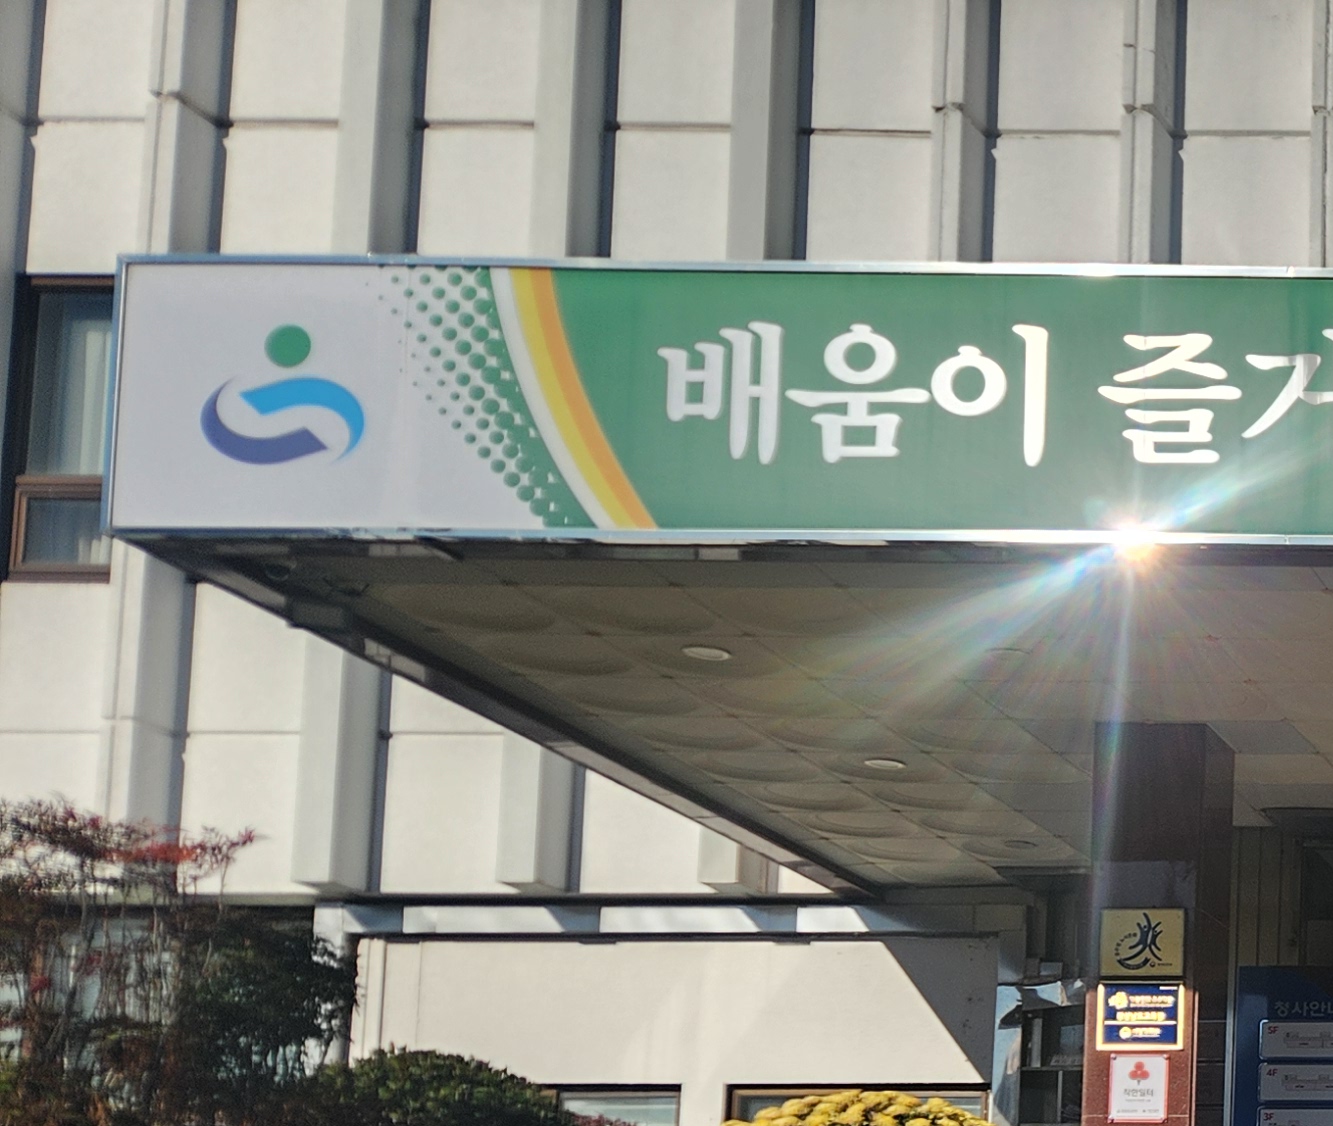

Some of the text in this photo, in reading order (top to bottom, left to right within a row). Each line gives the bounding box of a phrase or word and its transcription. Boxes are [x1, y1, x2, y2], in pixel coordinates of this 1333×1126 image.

[658, 321, 1047, 465] 배움이
[1267, 1026, 1279, 1035] 5F
[1266, 1068, 1278, 1077] 4F
[1263, 1112, 1275, 1121] 3F
